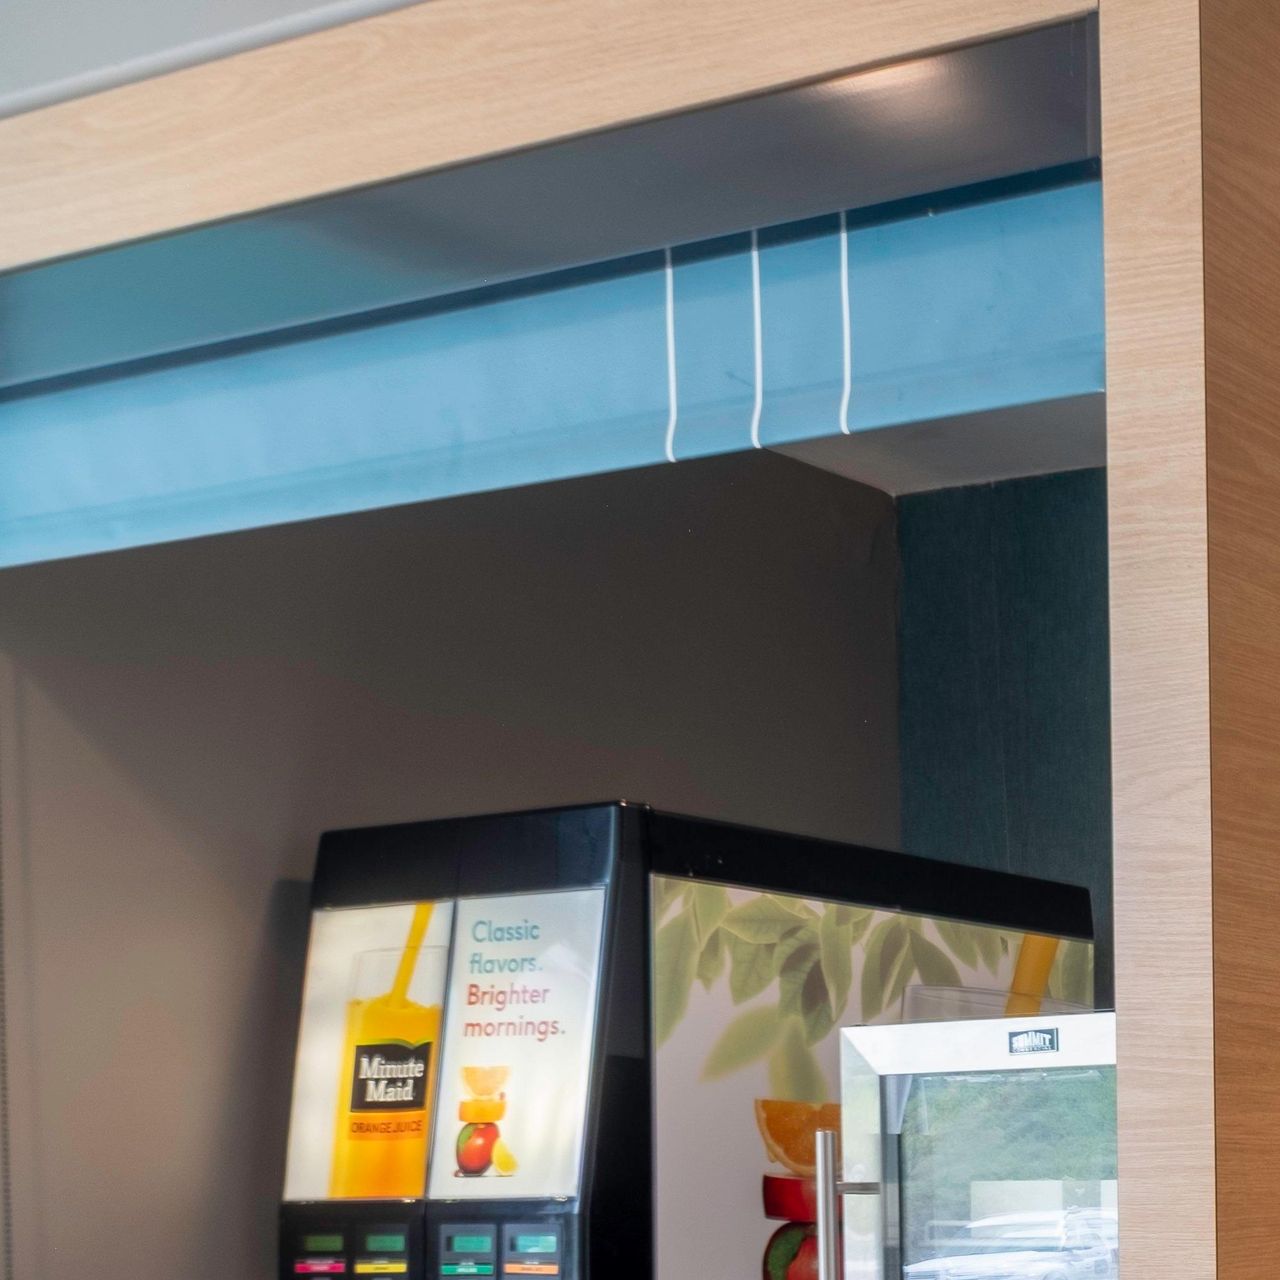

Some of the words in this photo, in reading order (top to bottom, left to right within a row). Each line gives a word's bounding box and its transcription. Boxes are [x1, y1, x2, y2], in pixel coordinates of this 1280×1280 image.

[472, 919, 540, 942] Classic
[469, 953, 543, 974] flavors.
[467, 982, 550, 1011] Brighter
[464, 1015, 566, 1042] mornings.
[1012, 1031, 1052, 1049] SUMMIT
[359, 1057, 425, 1080] Minute
[365, 1079, 414, 1102] Maid
[352, 1121, 392, 1134] ORANGE
[393, 1119, 423, 1133] JUICE
